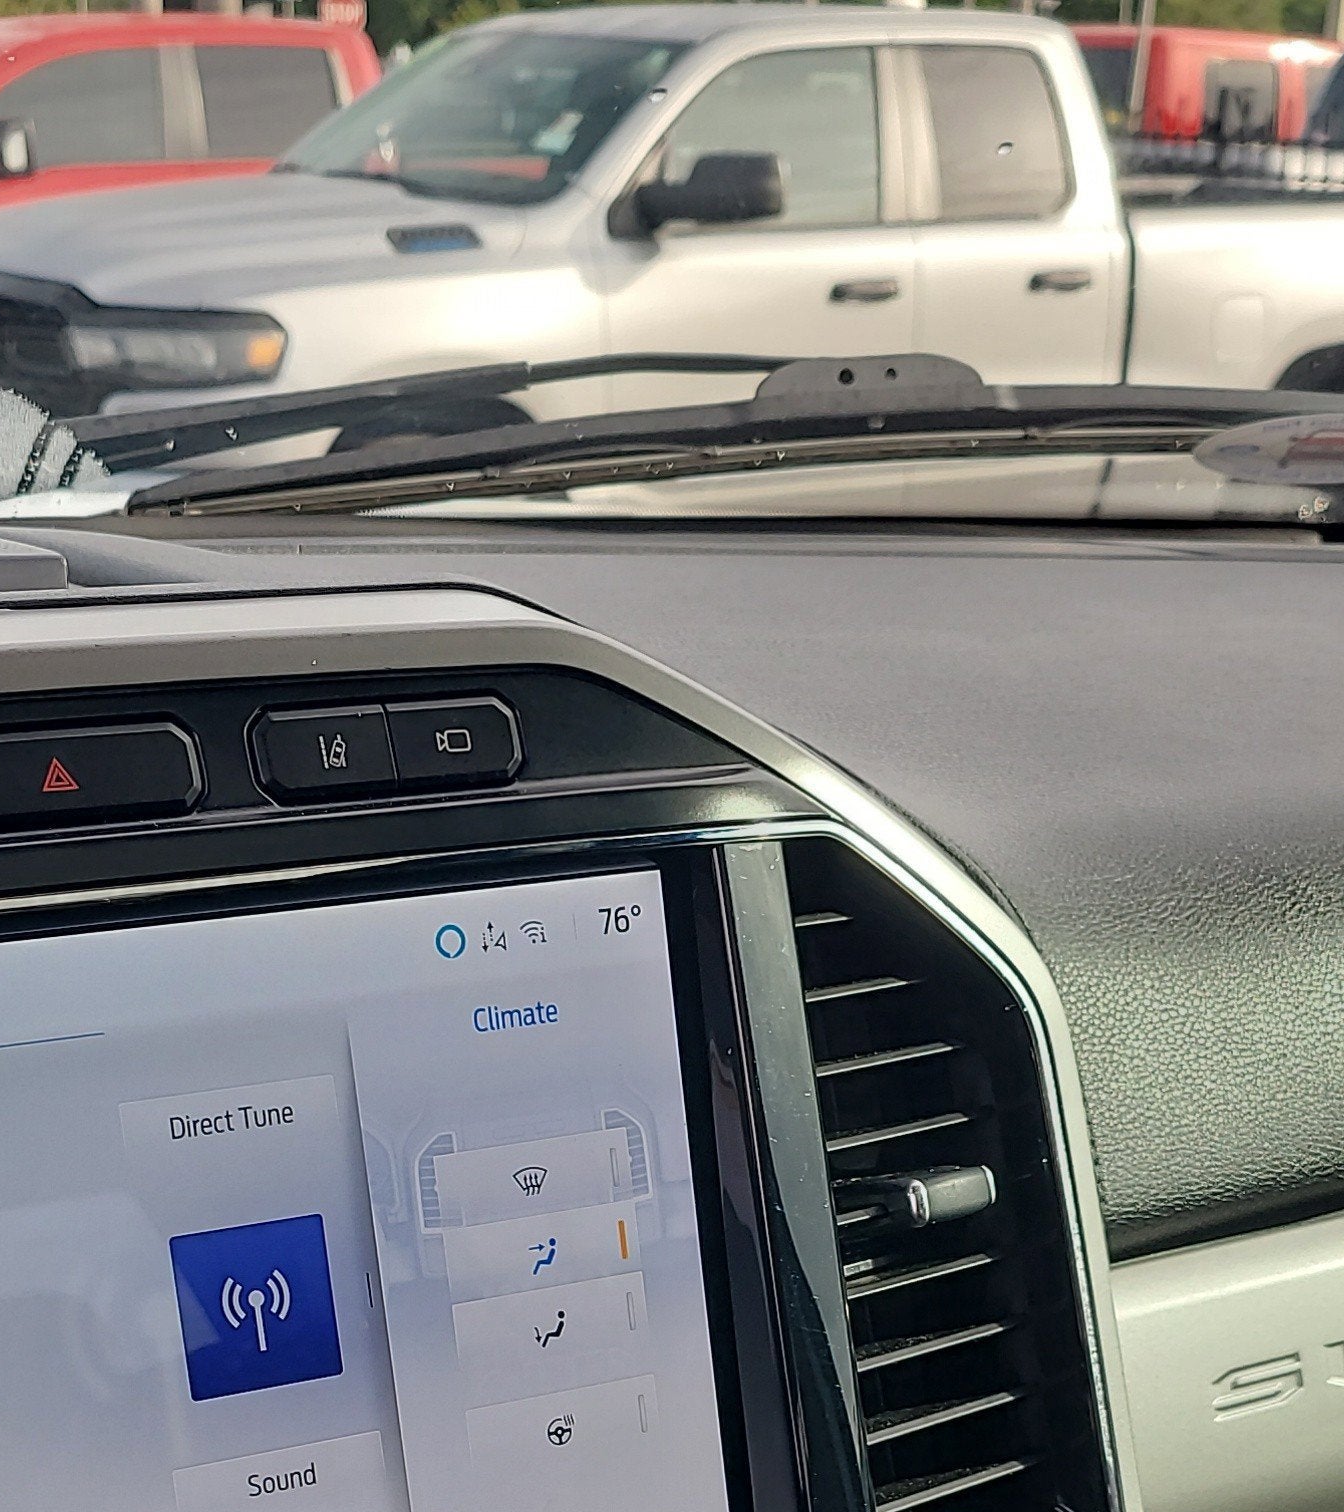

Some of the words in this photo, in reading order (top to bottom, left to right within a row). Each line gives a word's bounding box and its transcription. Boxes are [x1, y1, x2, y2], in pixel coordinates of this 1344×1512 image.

[598, 904, 641, 936] 76°
[473, 1002, 558, 1032] Climate
[169, 1110, 235, 1139] Direct
[238, 1104, 295, 1131] Tune
[247, 1463, 317, 1497] Sound
